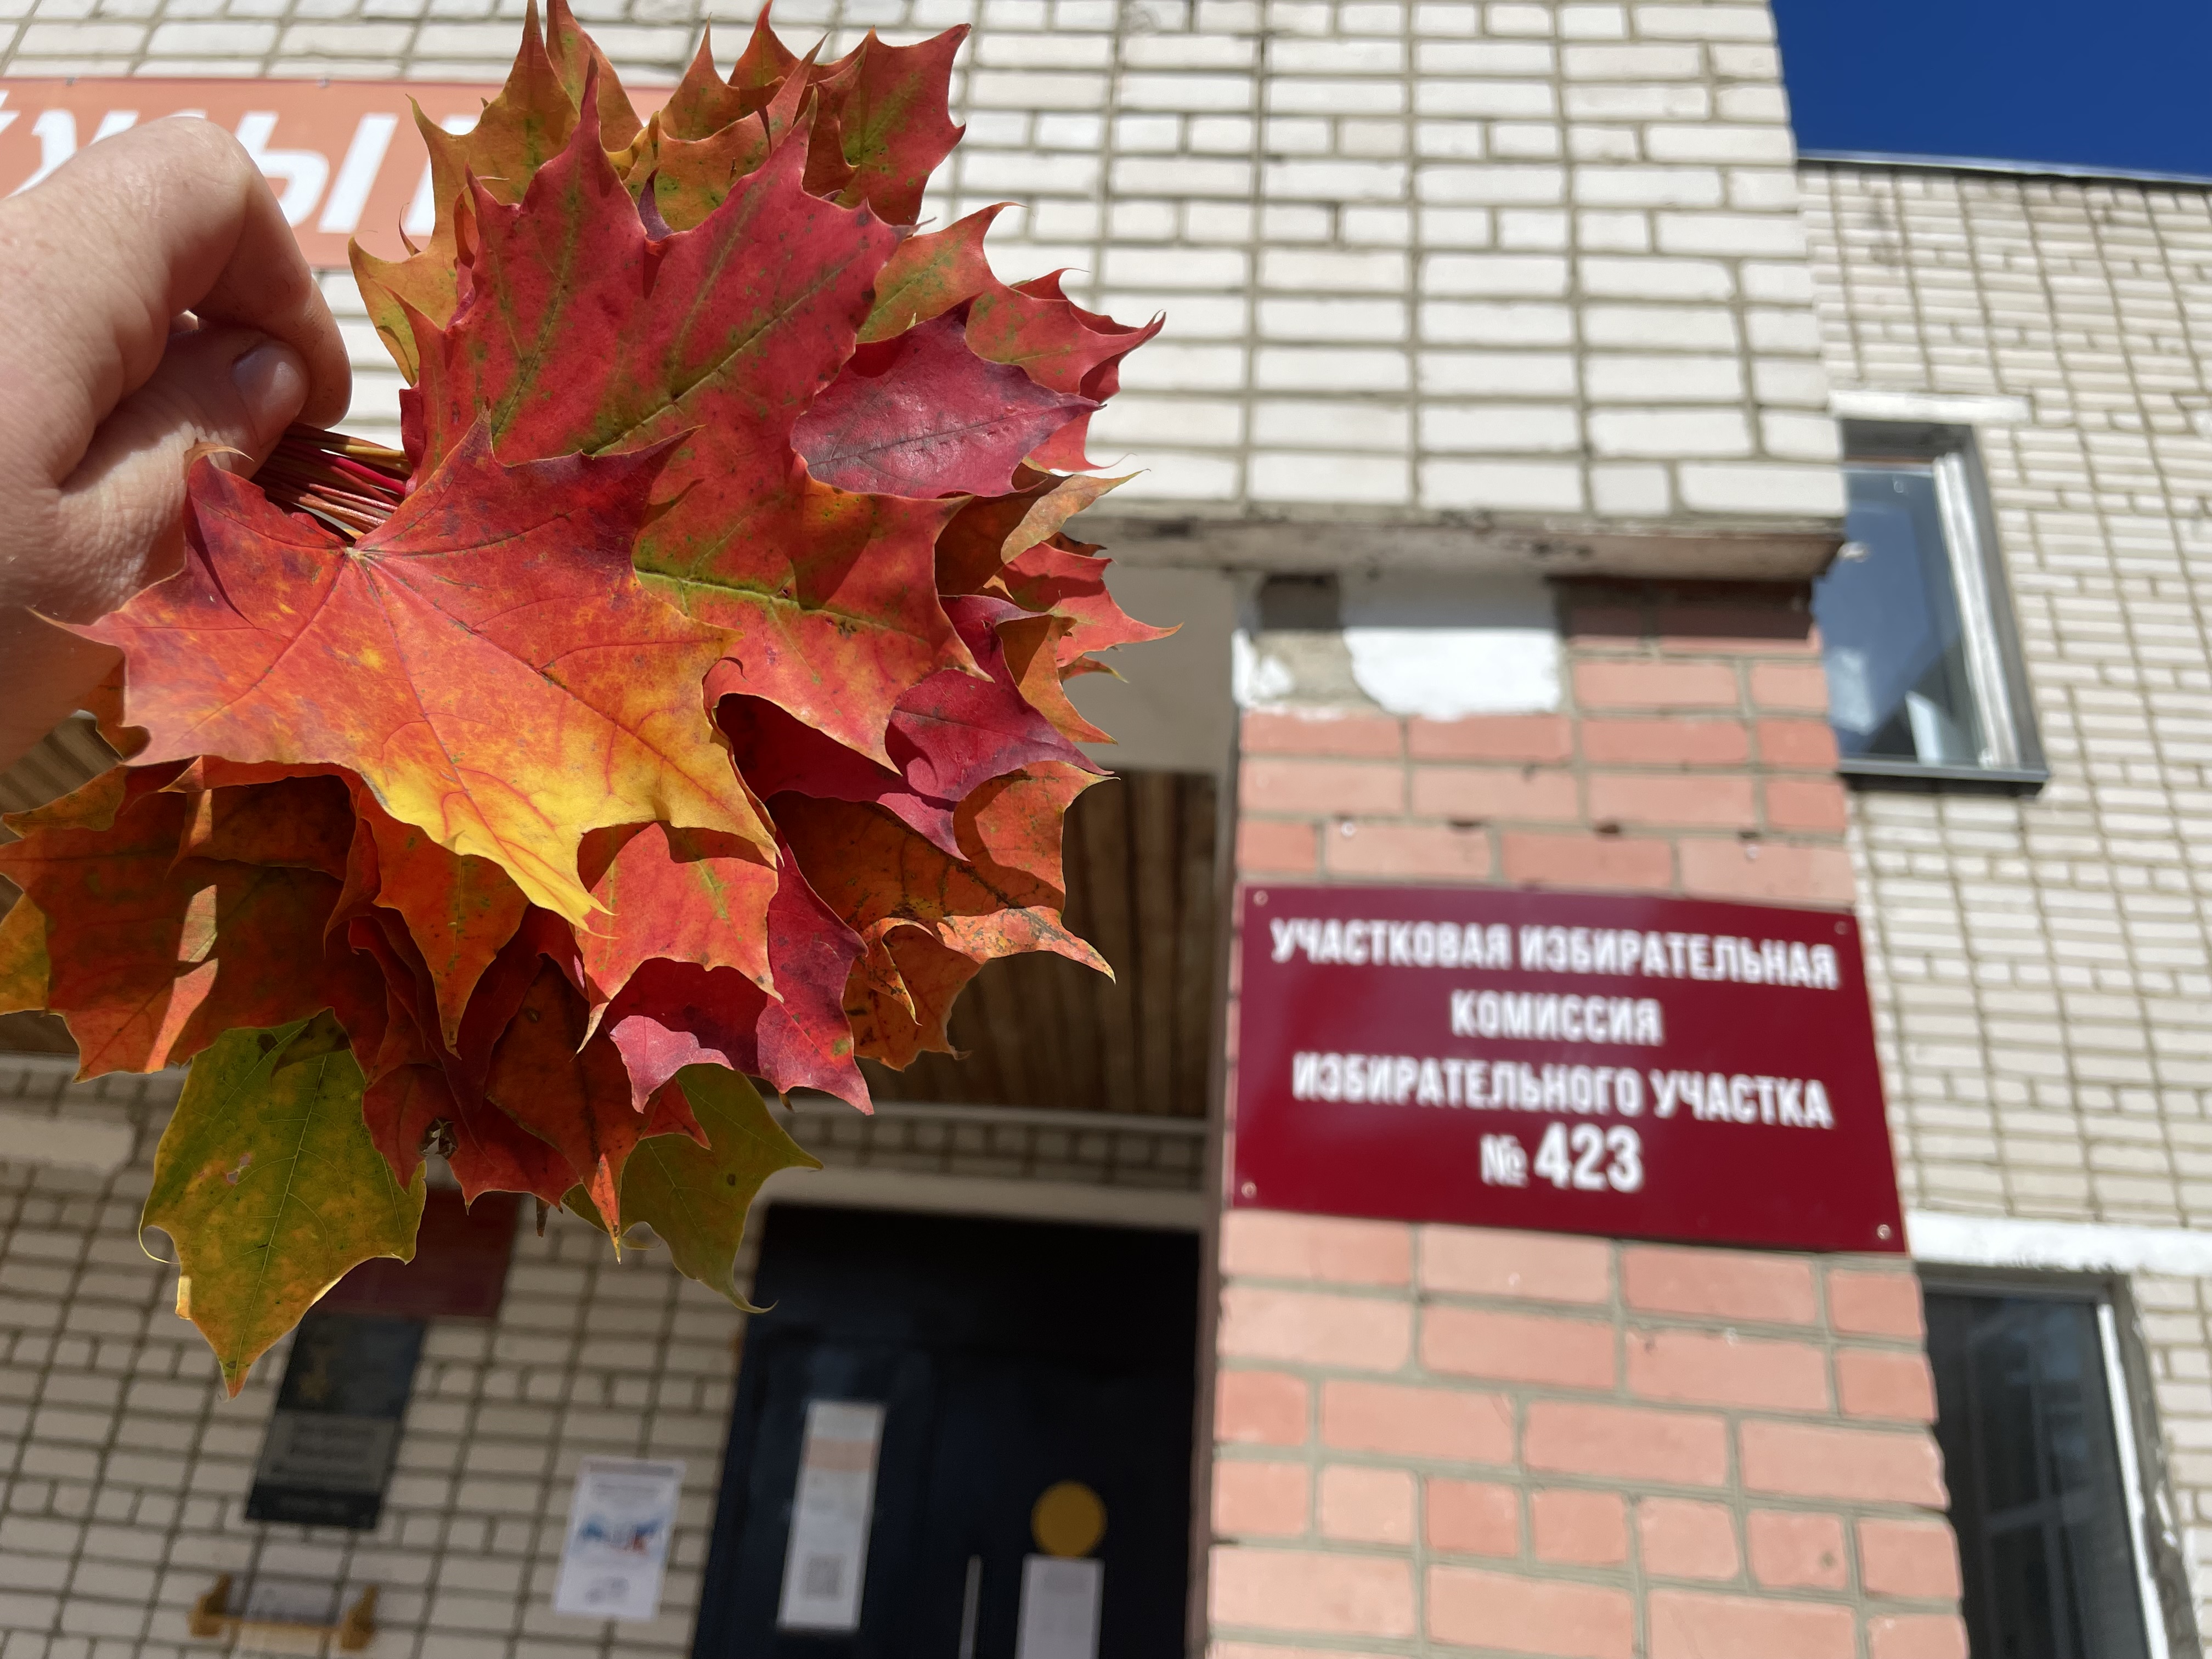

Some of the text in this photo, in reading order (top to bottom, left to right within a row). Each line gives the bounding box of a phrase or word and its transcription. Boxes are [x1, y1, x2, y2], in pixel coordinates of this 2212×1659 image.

[1269, 917, 1839, 990] УЧАСТКОВАЯ ИЗБИРАТЕЛЬНАЯ
[1449, 989, 1663, 1046] КОМИССИЯ
[1291, 1051, 1834, 1130] ИЗБИРАТЕЛЬНОГО УЧАСТКА
[1533, 1121, 1644, 1193] 423
